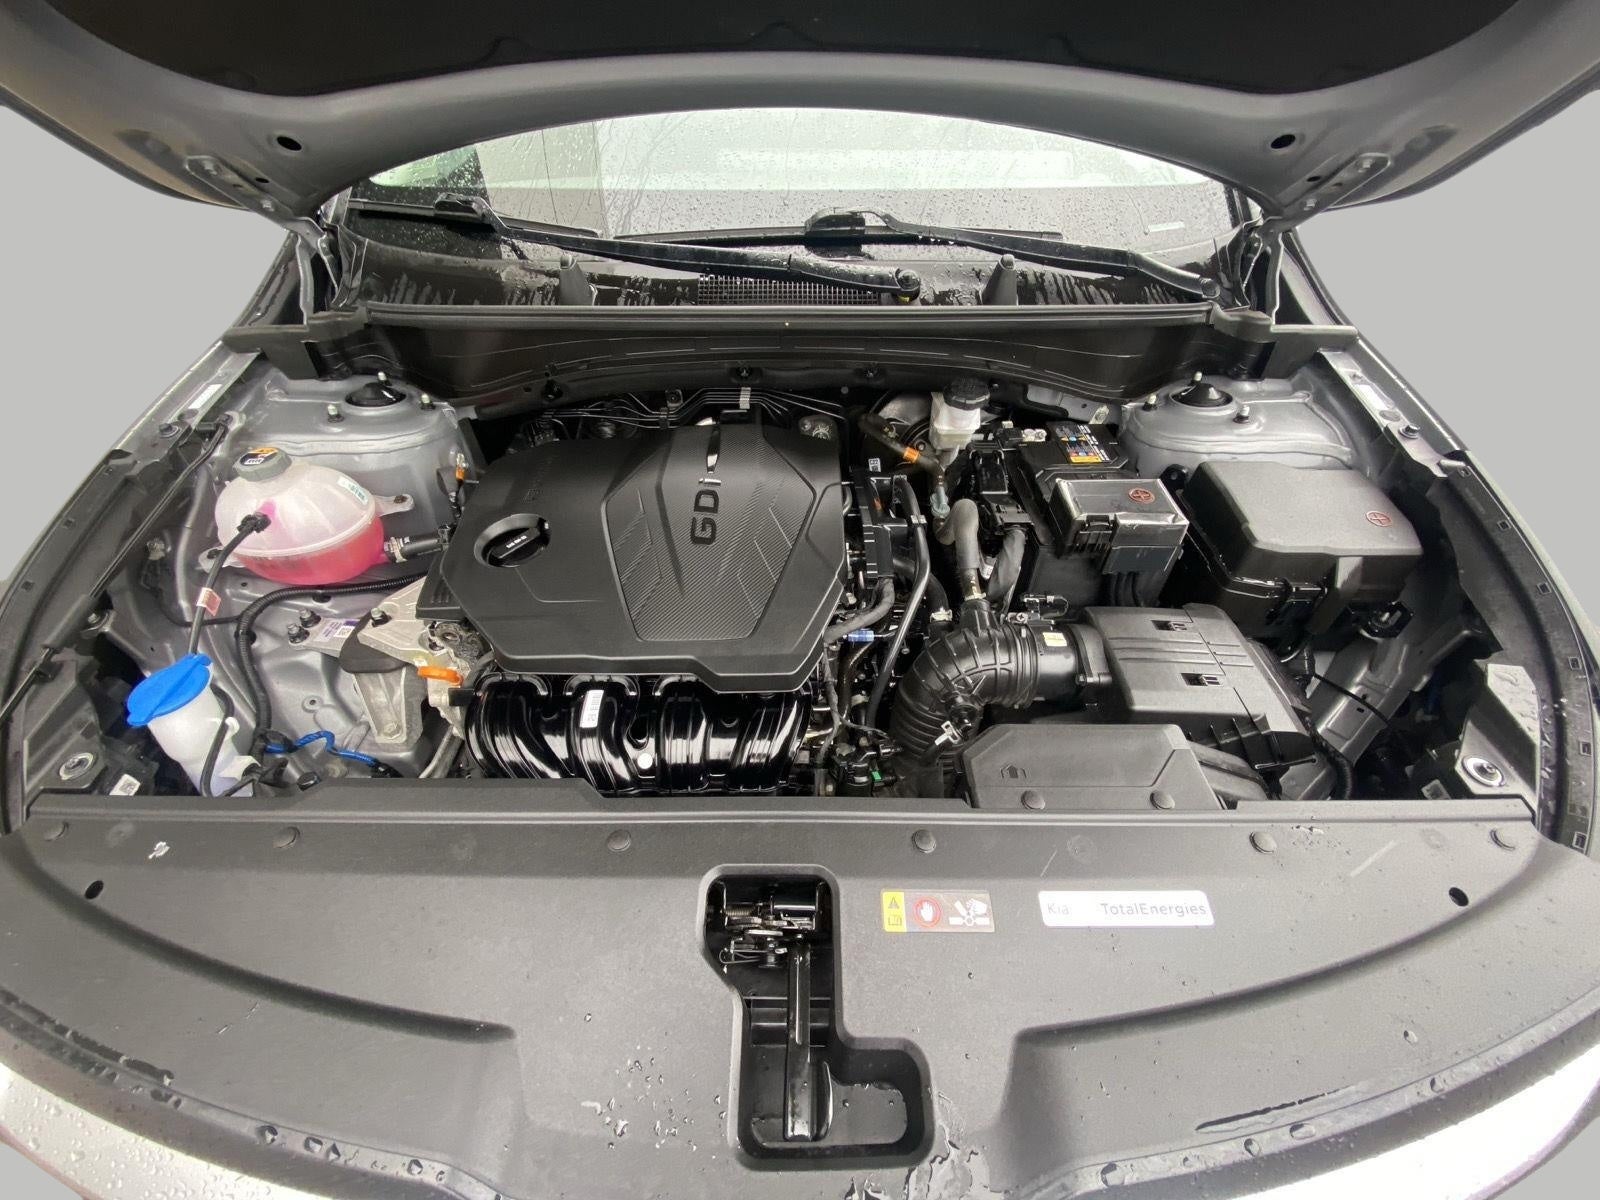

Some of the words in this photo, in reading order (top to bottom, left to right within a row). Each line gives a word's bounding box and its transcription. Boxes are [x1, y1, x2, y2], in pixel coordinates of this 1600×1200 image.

[690, 478, 721, 545] GDi
[1047, 903, 1069, 915] Kia
[1100, 903, 1206, 917] TotalEnergies
